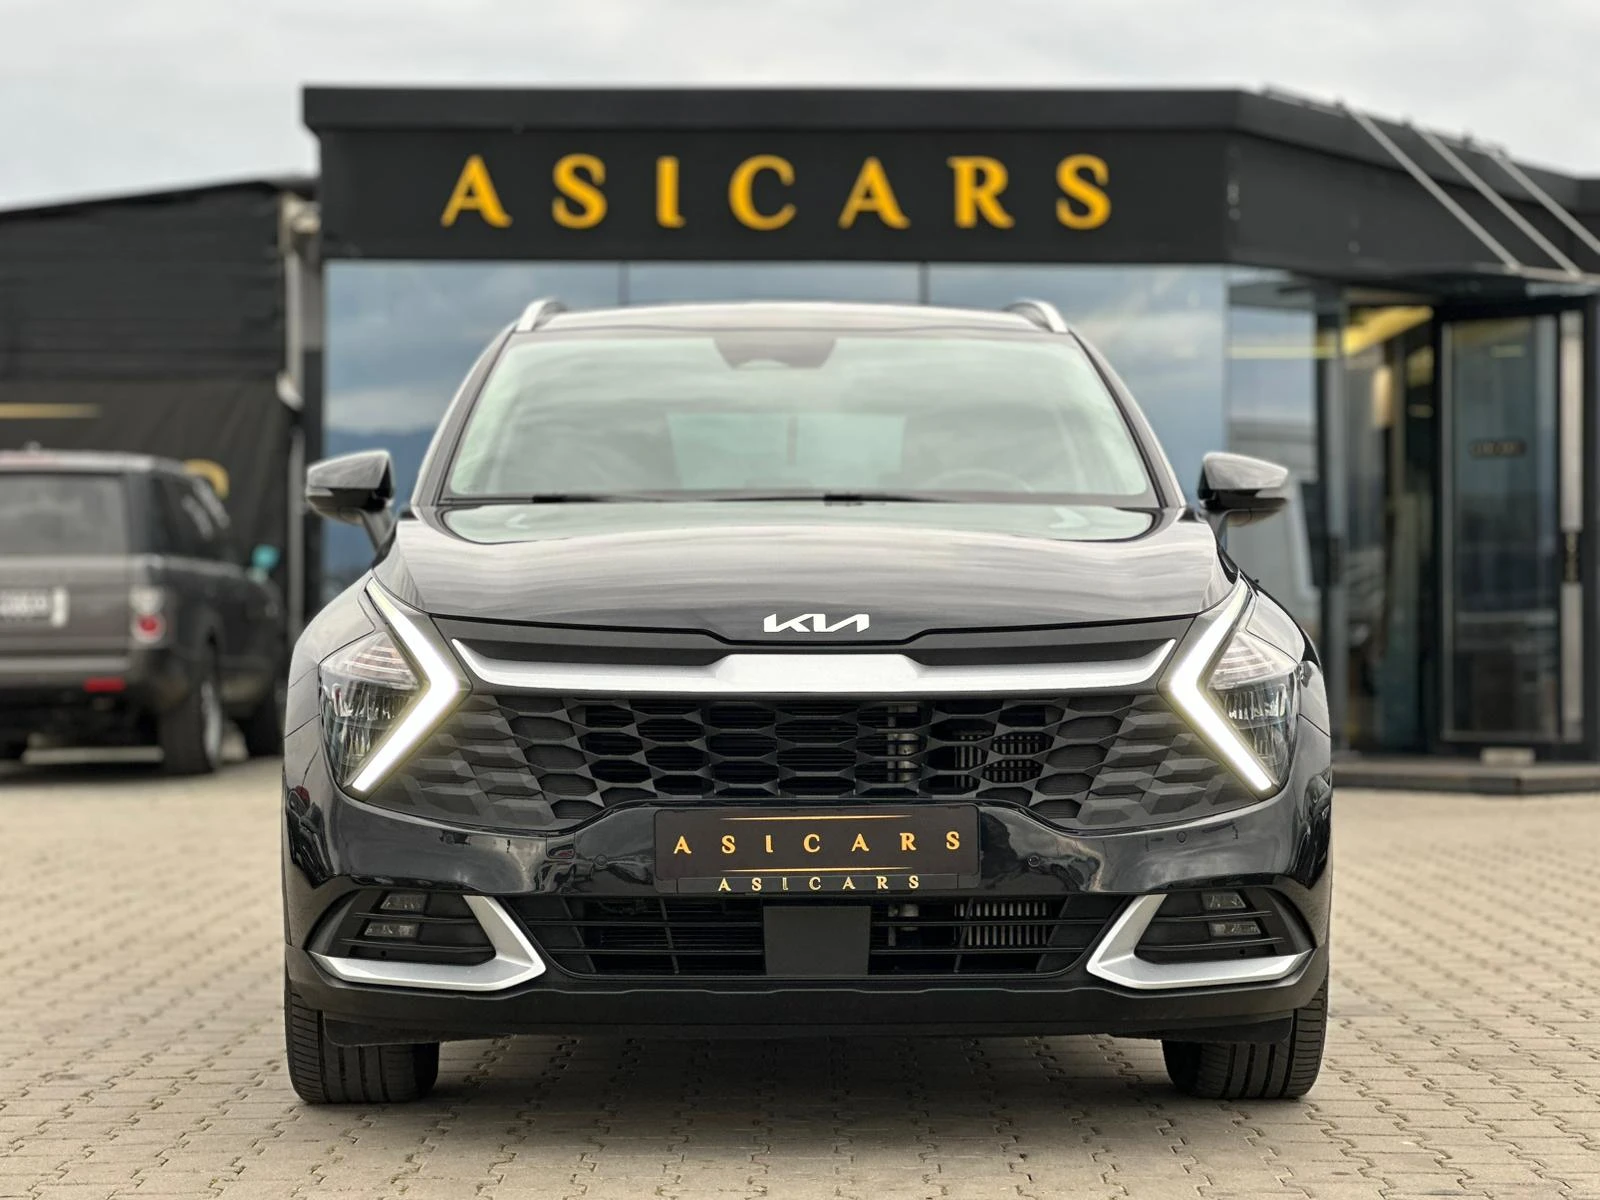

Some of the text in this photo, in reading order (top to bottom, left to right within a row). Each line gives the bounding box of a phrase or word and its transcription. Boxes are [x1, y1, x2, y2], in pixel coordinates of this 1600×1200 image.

[441, 153, 1111, 230] ASICARS
[763, 613, 870, 633] KIA
[673, 830, 960, 854] ASICARS
[718, 875, 919, 892] ASICARS
